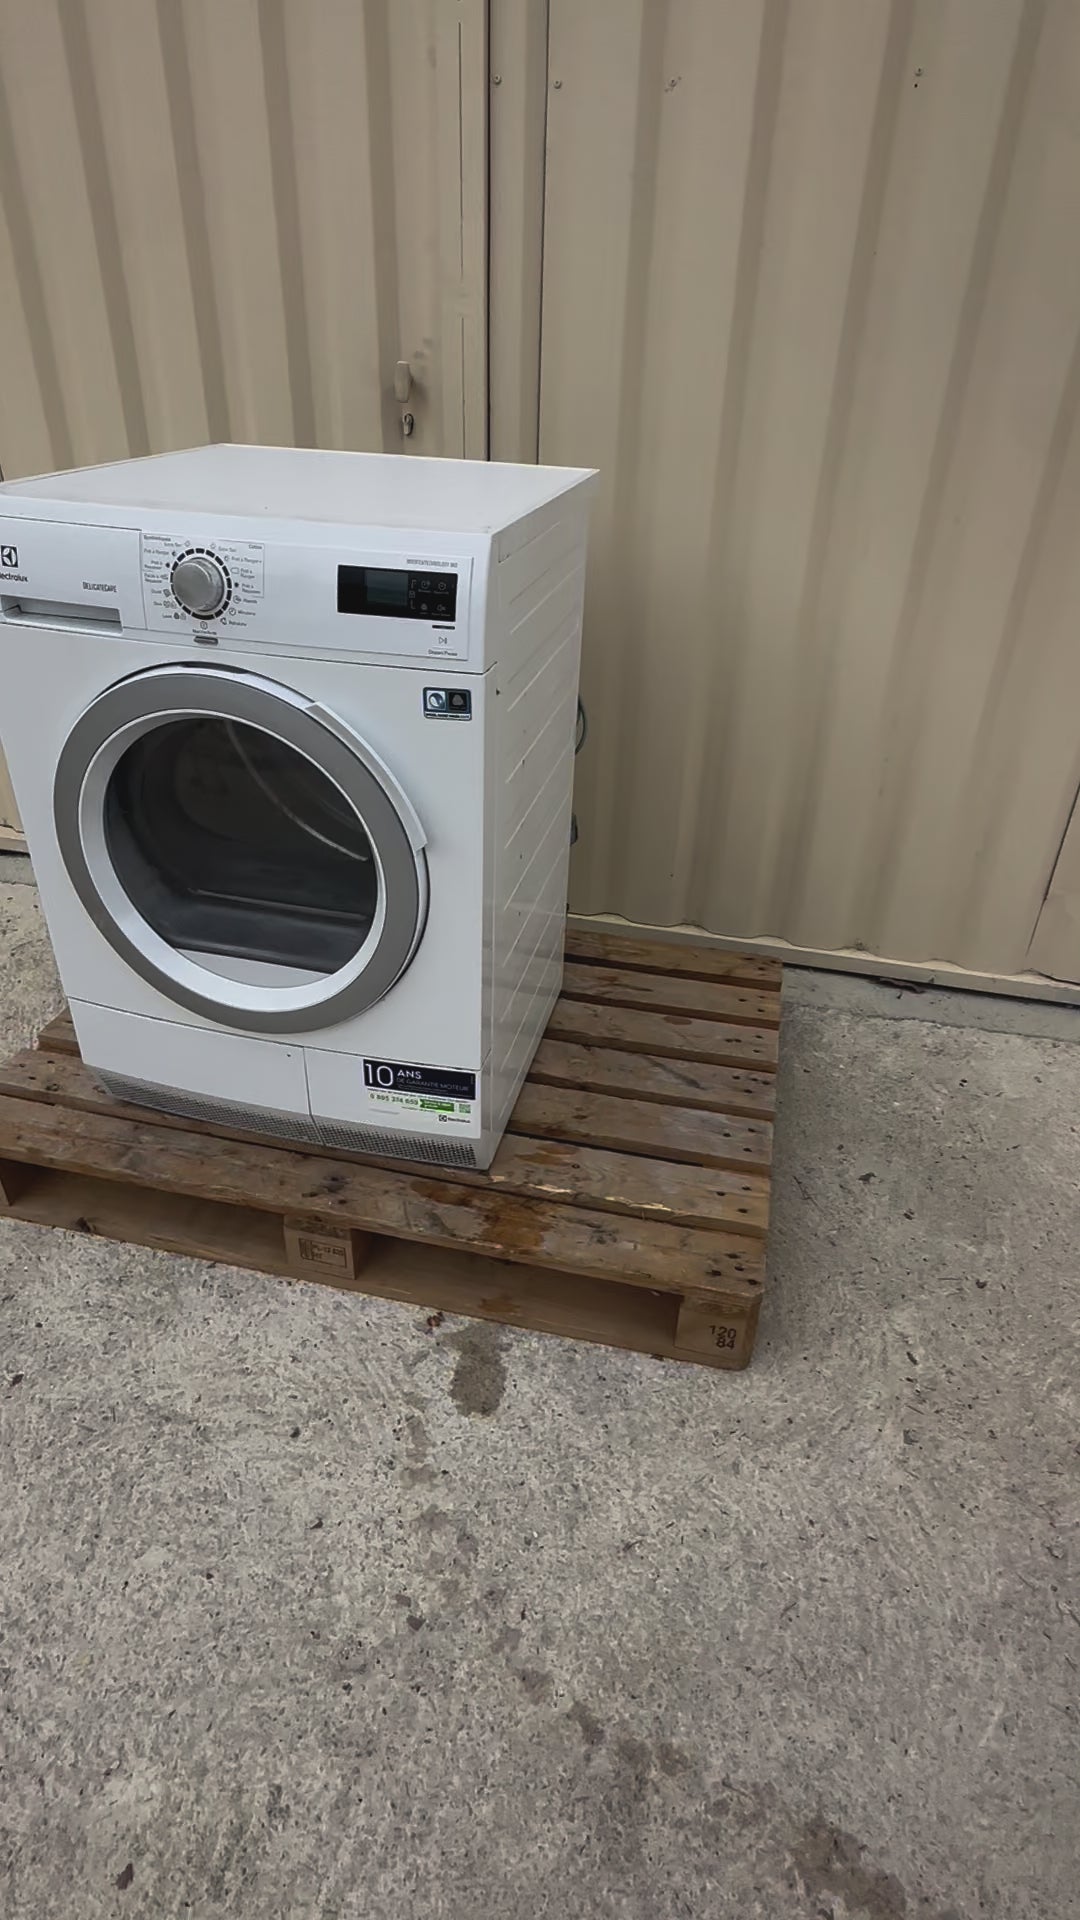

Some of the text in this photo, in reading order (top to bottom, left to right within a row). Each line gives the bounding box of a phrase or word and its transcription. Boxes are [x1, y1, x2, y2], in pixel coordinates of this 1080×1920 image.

[0, 572, 28, 582] lectrolux
[365, 1063, 422, 1087] 10 ANS
[406, 1079, 440, 1089] GARANTIE
[440, 1083, 470, 1092] MOTEUR
[709, 1325, 737, 1339] 120
[716, 1337, 735, 1350] 84
